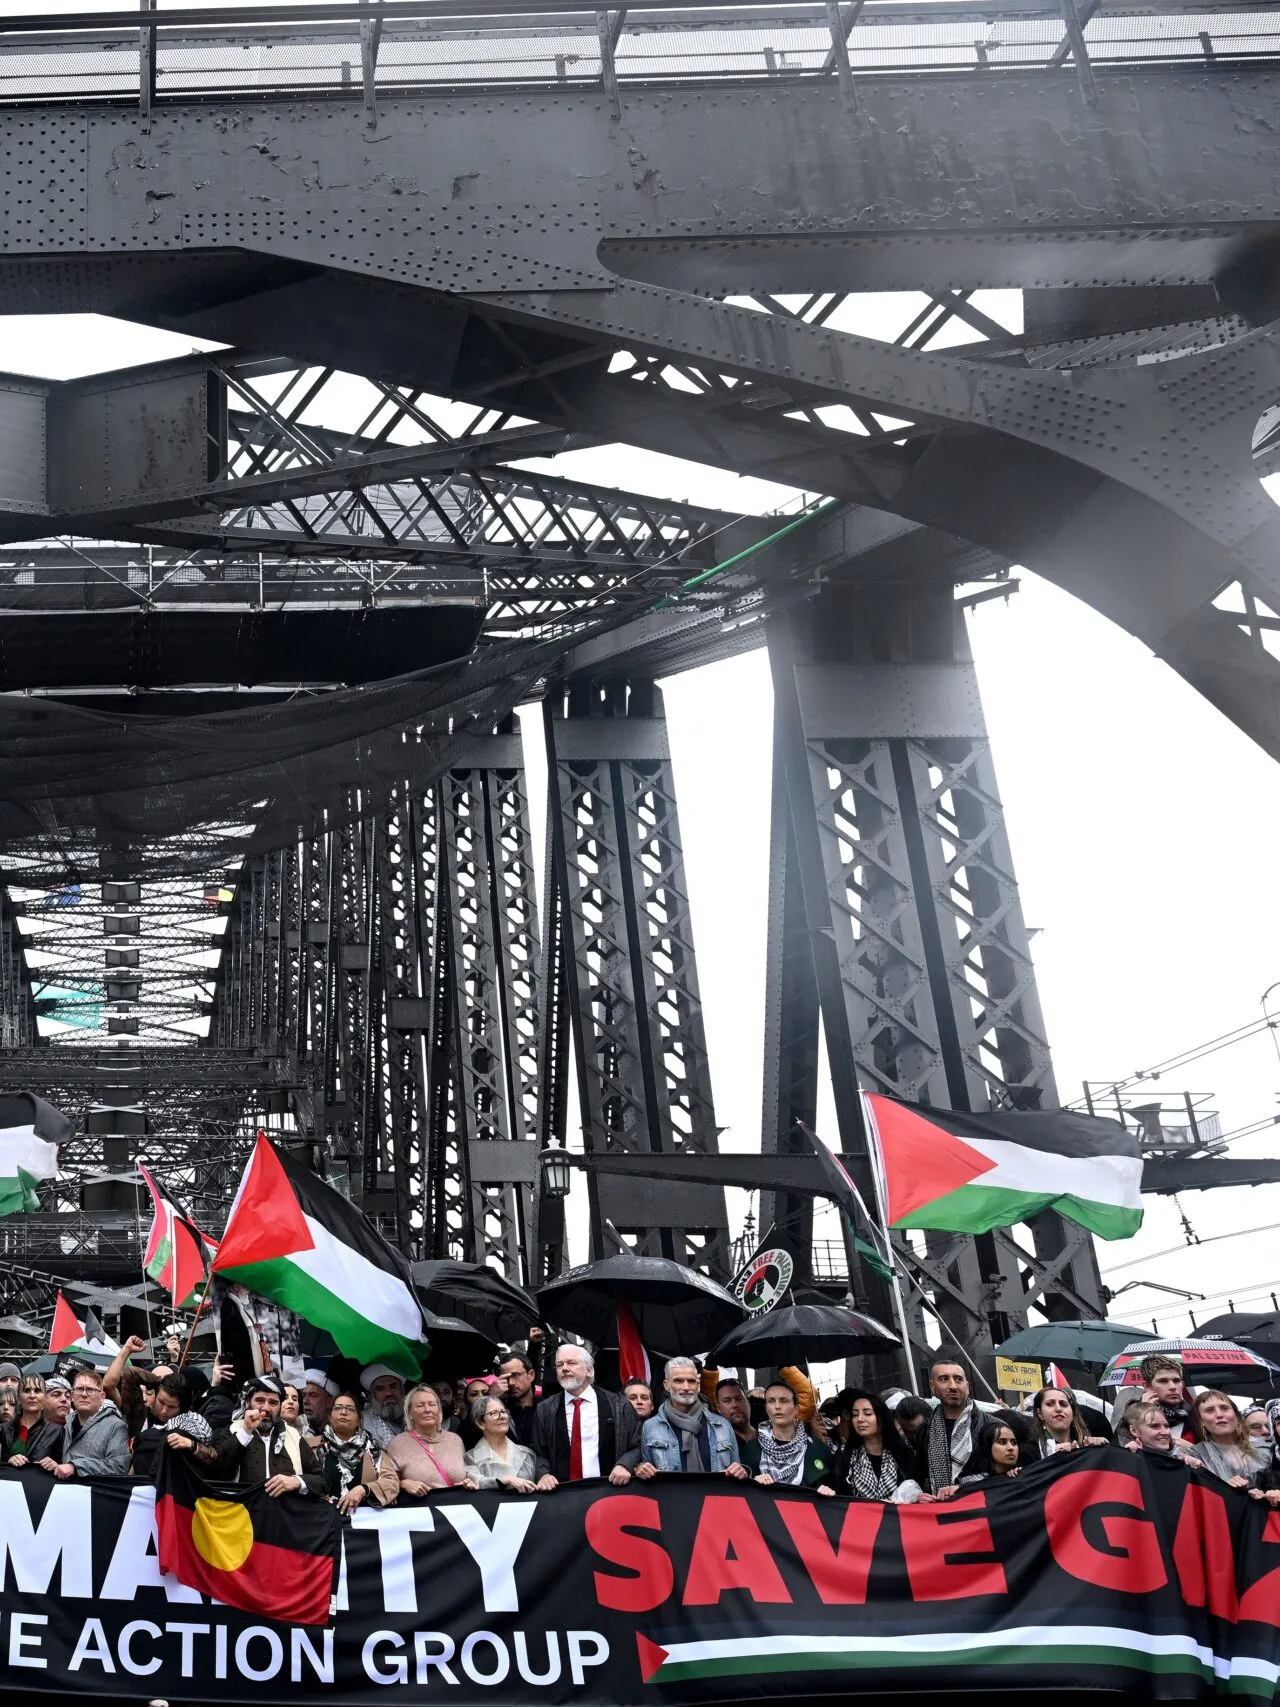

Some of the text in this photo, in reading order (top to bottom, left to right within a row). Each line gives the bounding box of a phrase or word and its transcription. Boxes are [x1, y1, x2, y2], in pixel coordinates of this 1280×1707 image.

[736, 1269, 753, 1296] END
[751, 1251, 791, 1298] FREE PALESTINE
[1184, 1352, 1247, 1361] PALESTINE
[584, 1490, 1007, 1613] SAVE
[68, 1617, 335, 1685] ACTION
[361, 1628, 611, 1687] GROUP
